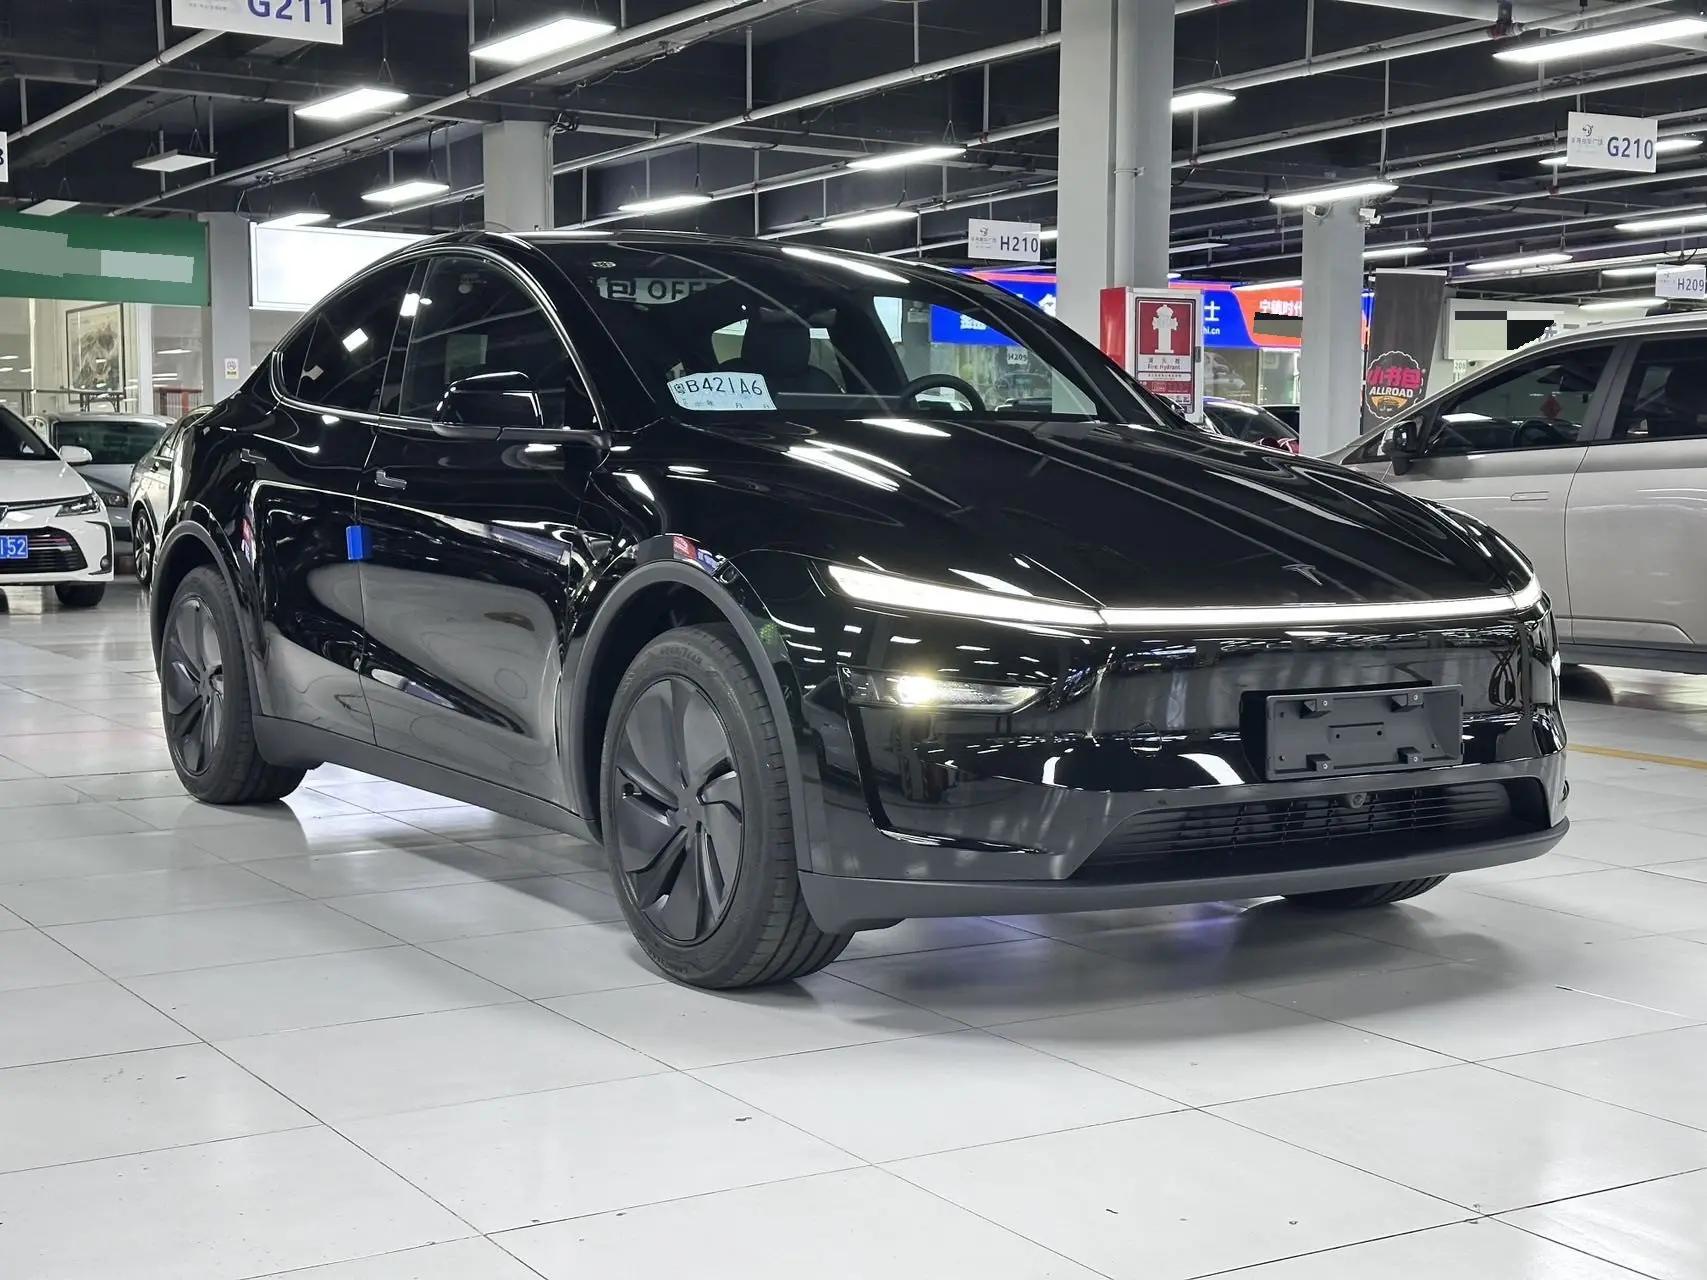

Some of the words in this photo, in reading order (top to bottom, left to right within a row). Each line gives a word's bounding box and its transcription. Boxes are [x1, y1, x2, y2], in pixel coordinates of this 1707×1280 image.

[247, 0, 333, 25] G211
[1607, 136, 1654, 160] G210
[1000, 236, 1040, 253] H210
[1677, 277, 1705, 292] H209
[1369, 386, 1414, 398] ALLROAD
